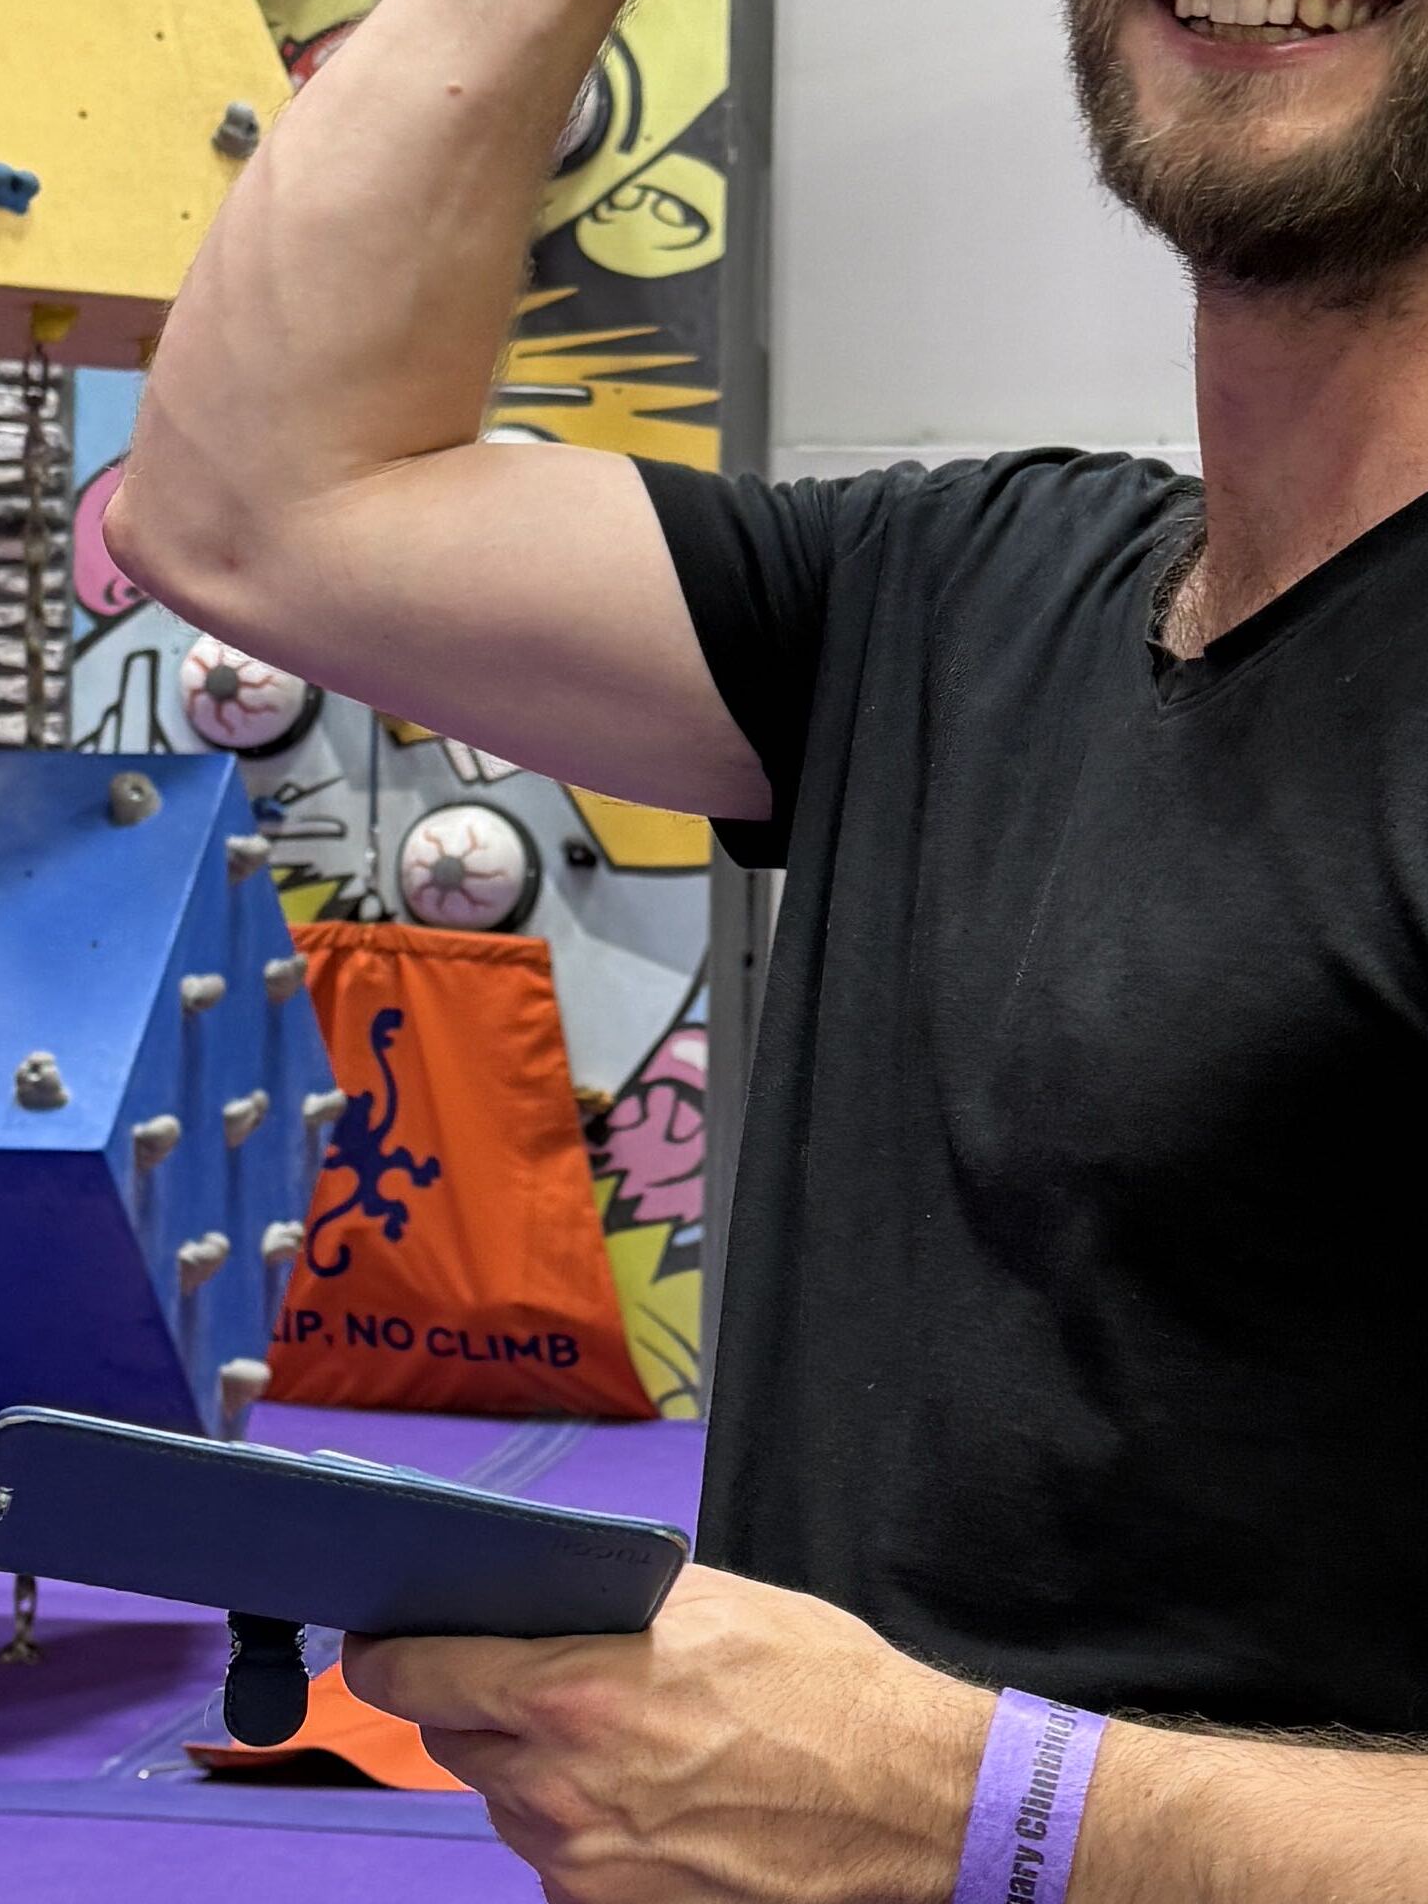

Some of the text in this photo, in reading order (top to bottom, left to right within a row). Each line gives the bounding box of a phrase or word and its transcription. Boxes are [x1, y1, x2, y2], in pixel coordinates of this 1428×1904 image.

[272, 1307, 581, 1368] IP, NO CLIMB
[1015, 1712, 1078, 1842] Climbing
